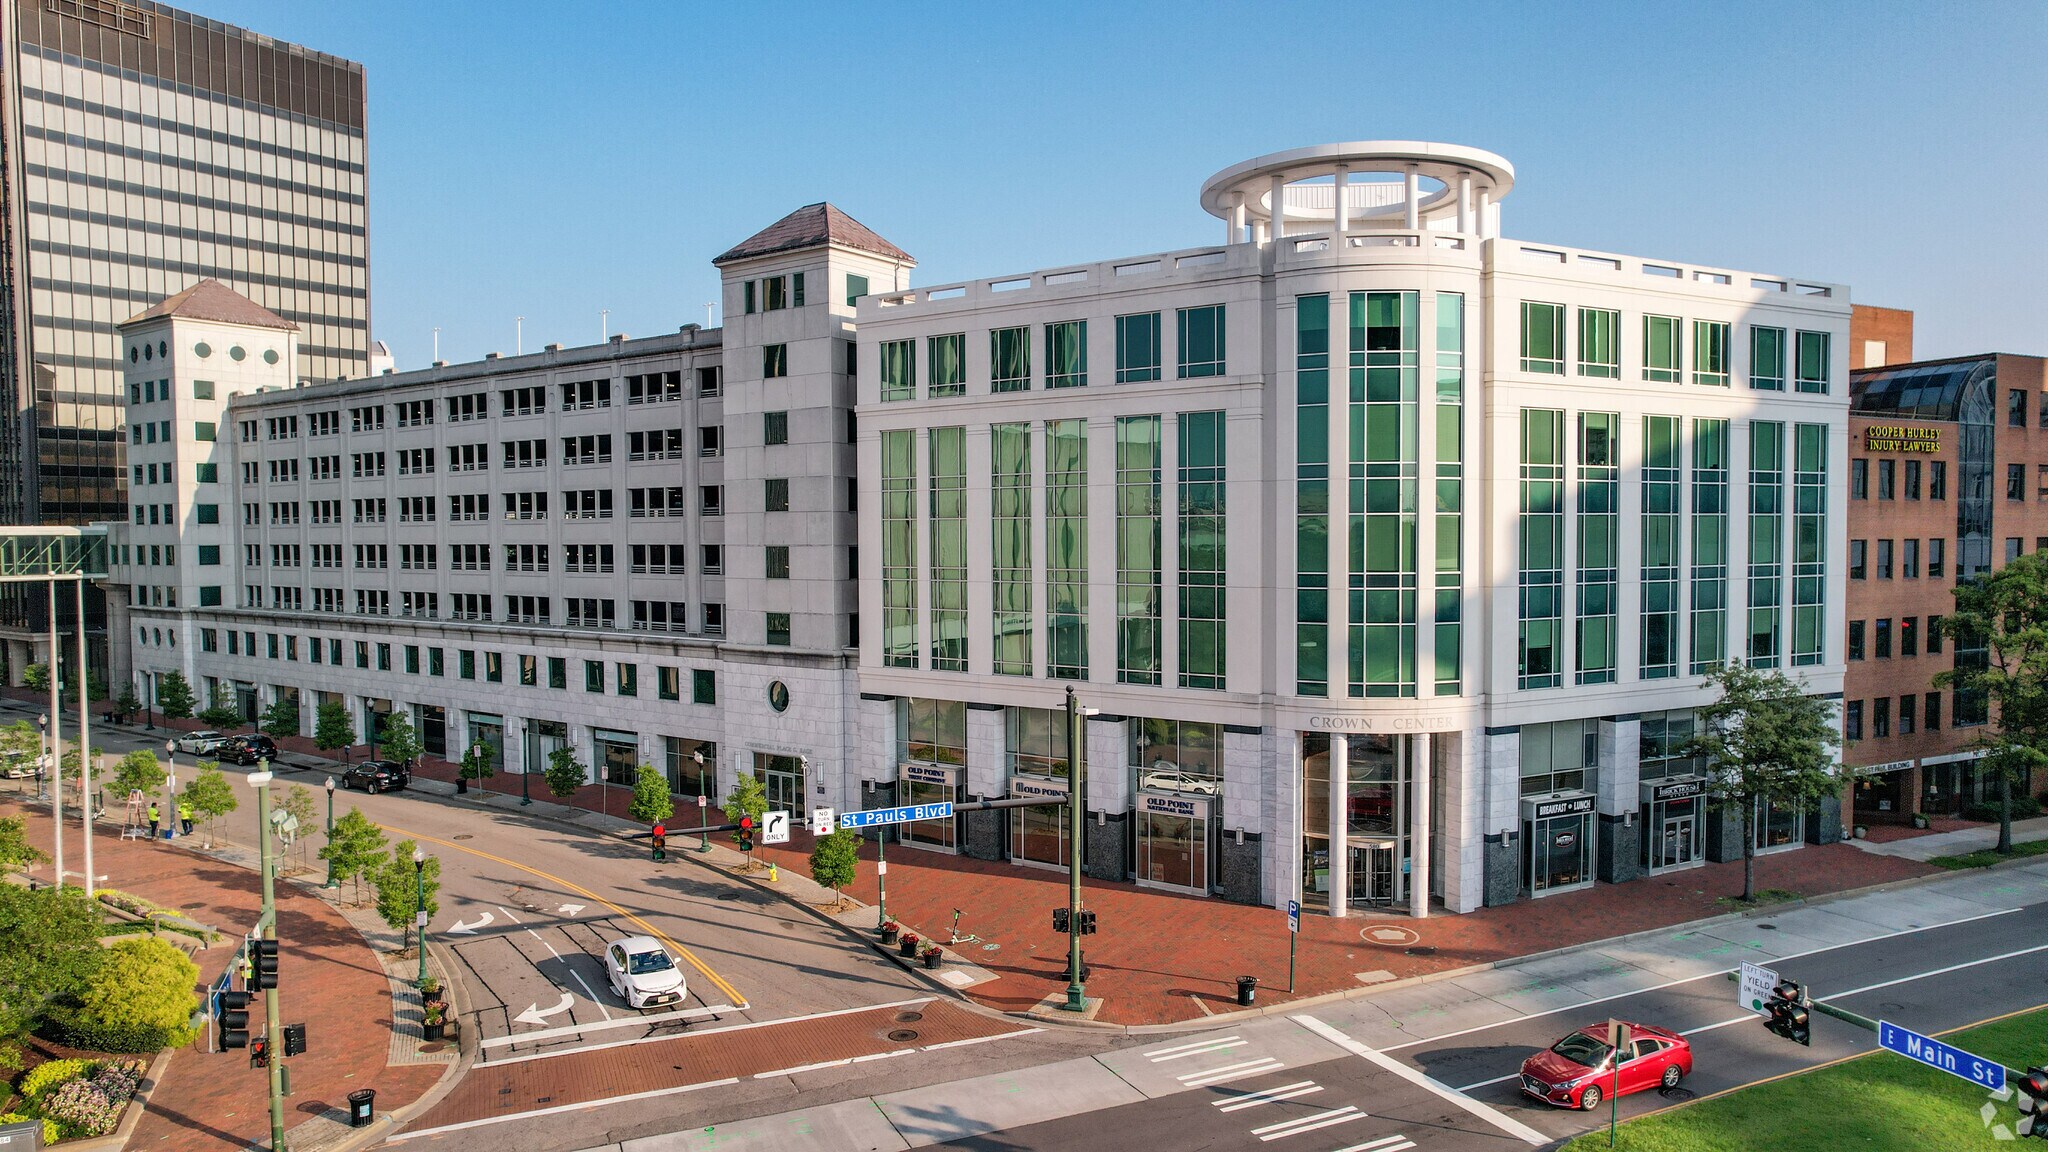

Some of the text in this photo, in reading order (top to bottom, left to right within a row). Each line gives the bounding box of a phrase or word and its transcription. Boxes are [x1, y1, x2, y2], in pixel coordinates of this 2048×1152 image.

[1869, 425, 1941, 440] COOPER HURLEY
[1869, 439, 1941, 453] INJURY LAWYERS
[1310, 716, 1454, 730] CROWN CENTER
[907, 766, 946, 778] OLD POINT
[1887, 761, 1910, 771] BUILDING
[1024, 786, 1041, 795] OLD
[1147, 797, 1195, 810] OLD POINT
[1147, 804, 1195, 816] NATIONAL BANK
[1539, 799, 1591, 816] BREAKFAST LUNCH
[842, 803, 946, 827] St Pauls Blvd
[766, 833, 785, 841] ONLY
[1290, 901, 1297, 914] P
[1744, 964, 1775, 981] LEFT TURN
[1743, 984, 1752, 993] ON
[1747, 975, 1770, 990] YIELD
[1888, 1029, 1995, 1085] E Main St
